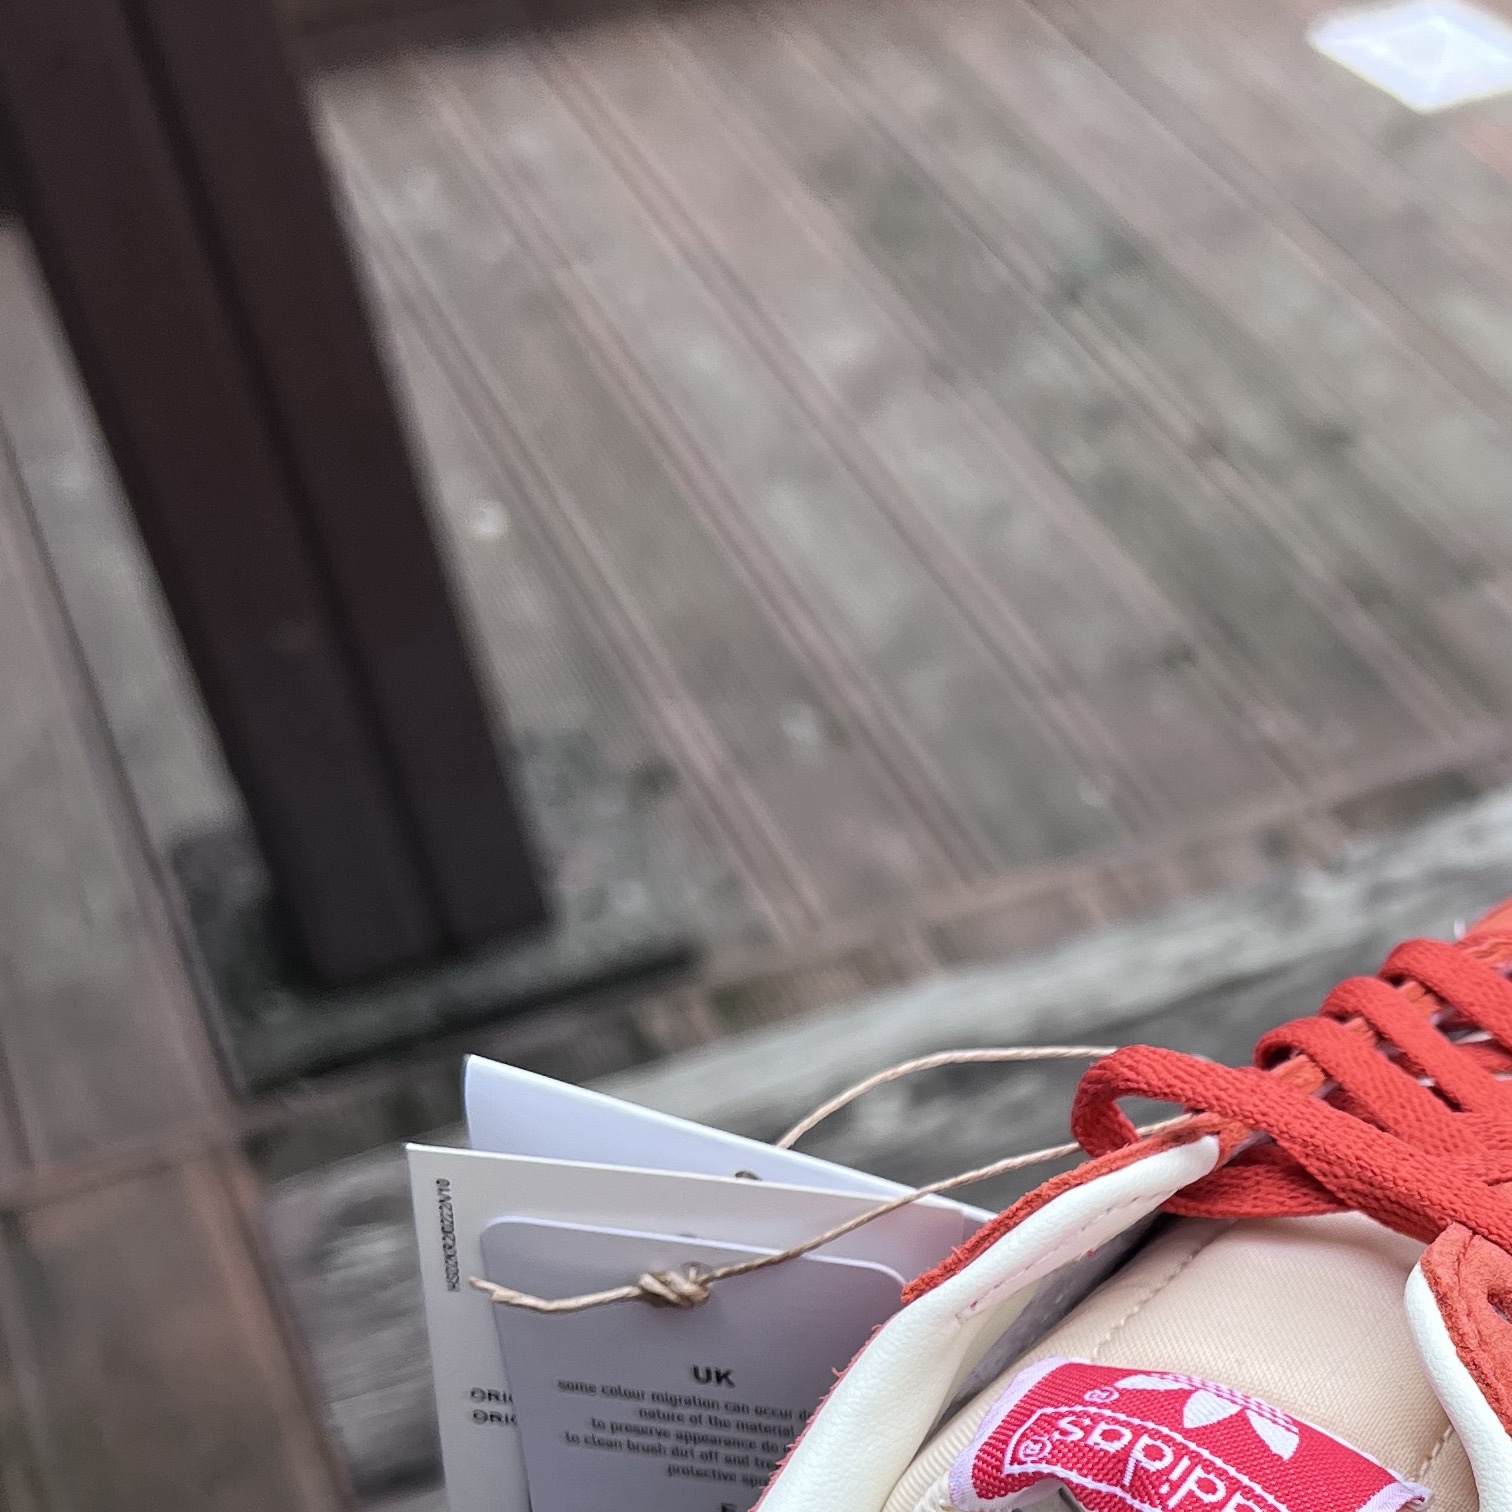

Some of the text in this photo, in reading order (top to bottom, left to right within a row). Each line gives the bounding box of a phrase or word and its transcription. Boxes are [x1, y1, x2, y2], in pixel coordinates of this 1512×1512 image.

[692, 1365, 736, 1388] UK
[601, 1384, 645, 1401] colour
[650, 1389, 720, 1411] migration
[724, 1401, 750, 1414] can
[591, 1416, 606, 1430] to
[610, 1420, 671, 1439] preserve
[675, 1429, 757, 1450] appearance
[639, 1407, 796, 1437] nature of the material
[565, 1431, 580, 1444] to
[584, 1433, 623, 1450] clean
[626, 1438, 667, 1456] brush
[724, 1452, 749, 1467] and
[667, 1464, 737, 1482] protective
